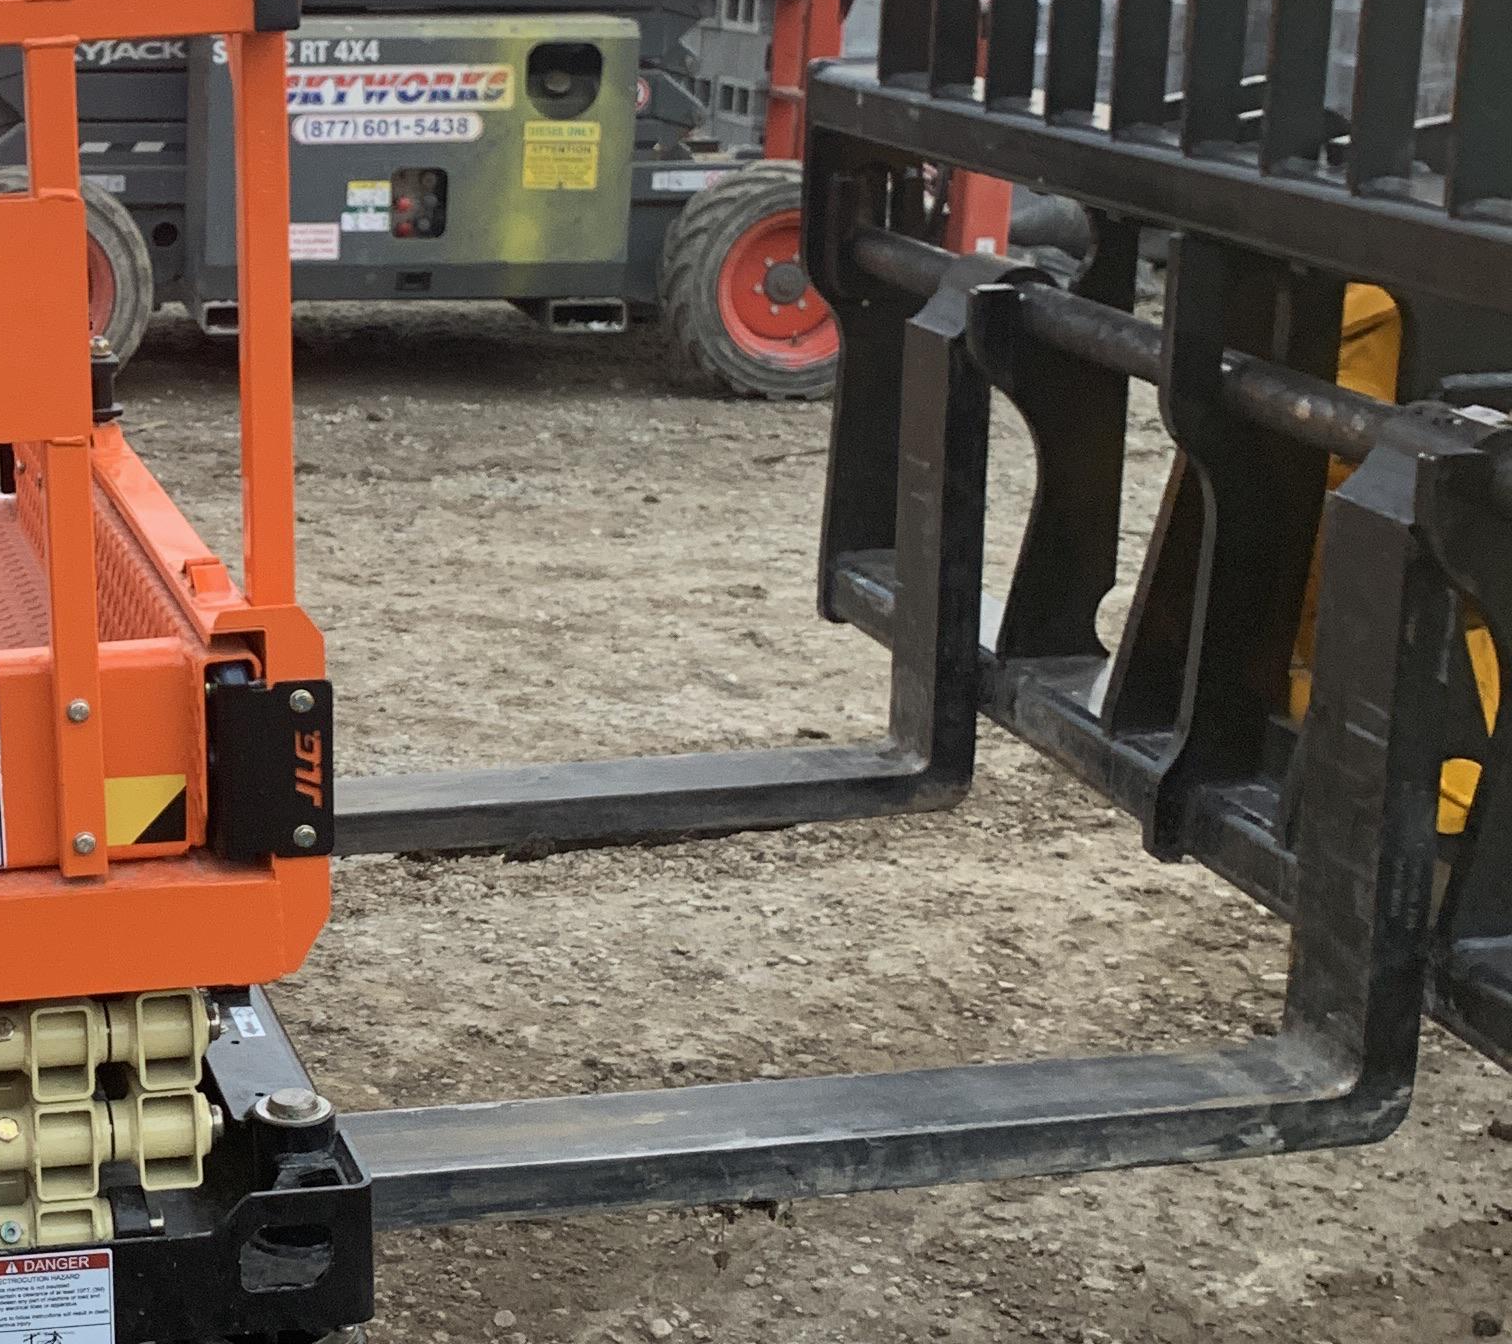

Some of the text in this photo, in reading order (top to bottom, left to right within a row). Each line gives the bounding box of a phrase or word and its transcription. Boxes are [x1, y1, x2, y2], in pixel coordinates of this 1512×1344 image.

[75, 39, 187, 66] YJACK
[300, 39, 330, 63] RT
[334, 39, 381, 63] 4X4
[303, 117, 470, 140] (877) 601-5438
[293, 729, 324, 809] JLG
[24, 1256, 90, 1273] DANGER
